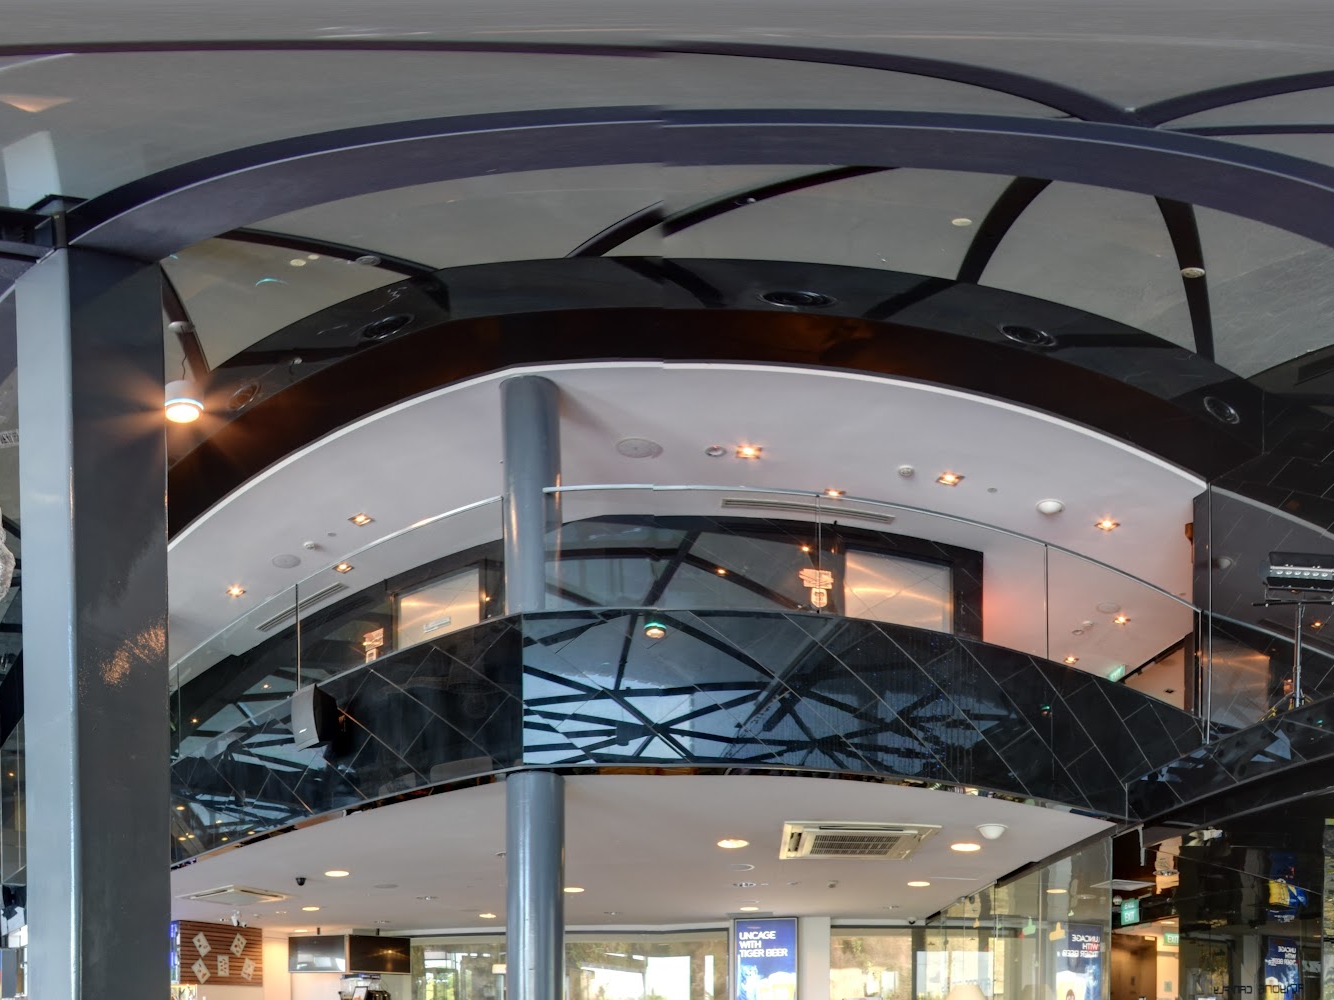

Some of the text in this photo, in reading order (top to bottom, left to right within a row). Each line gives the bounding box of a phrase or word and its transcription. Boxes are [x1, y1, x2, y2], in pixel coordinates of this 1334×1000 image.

[739, 931, 776, 940] UNCAGE
[739, 940, 762, 949] WITH
[739, 948, 788, 958] TIGER BEER
